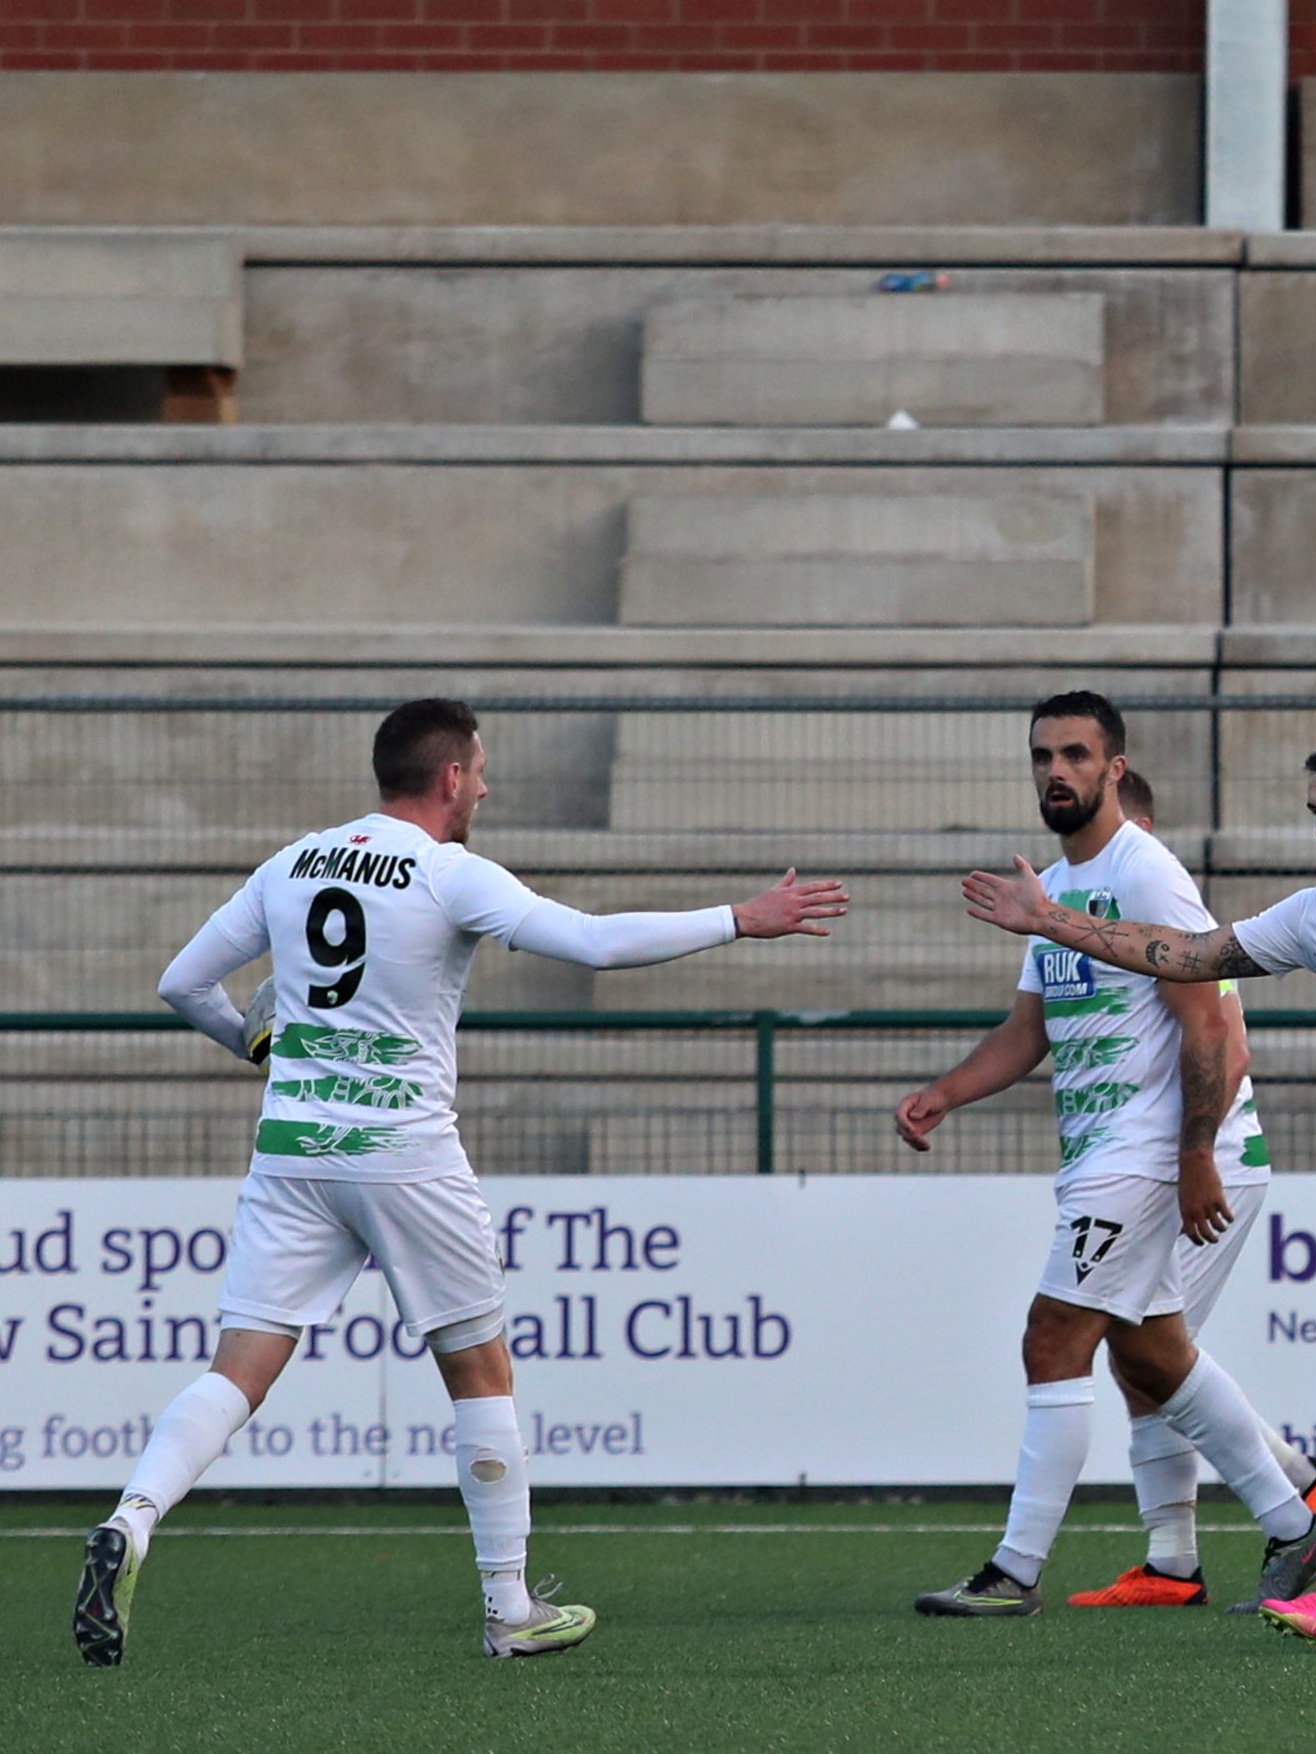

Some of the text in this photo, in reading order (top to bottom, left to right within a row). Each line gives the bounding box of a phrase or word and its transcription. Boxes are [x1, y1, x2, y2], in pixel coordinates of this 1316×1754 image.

[289, 848, 417, 890] McMANUS
[305, 886, 366, 1010] 9
[1044, 950, 1083, 984] RUK
[547, 1207, 681, 1272] The
[1070, 1215, 1123, 1263] 17
[46, 1298, 222, 1363] Sain
[625, 1296, 792, 1361] Club
[248, 1420, 294, 1457] to
[310, 1412, 391, 1457] the
[532, 1412, 645, 1457] level
